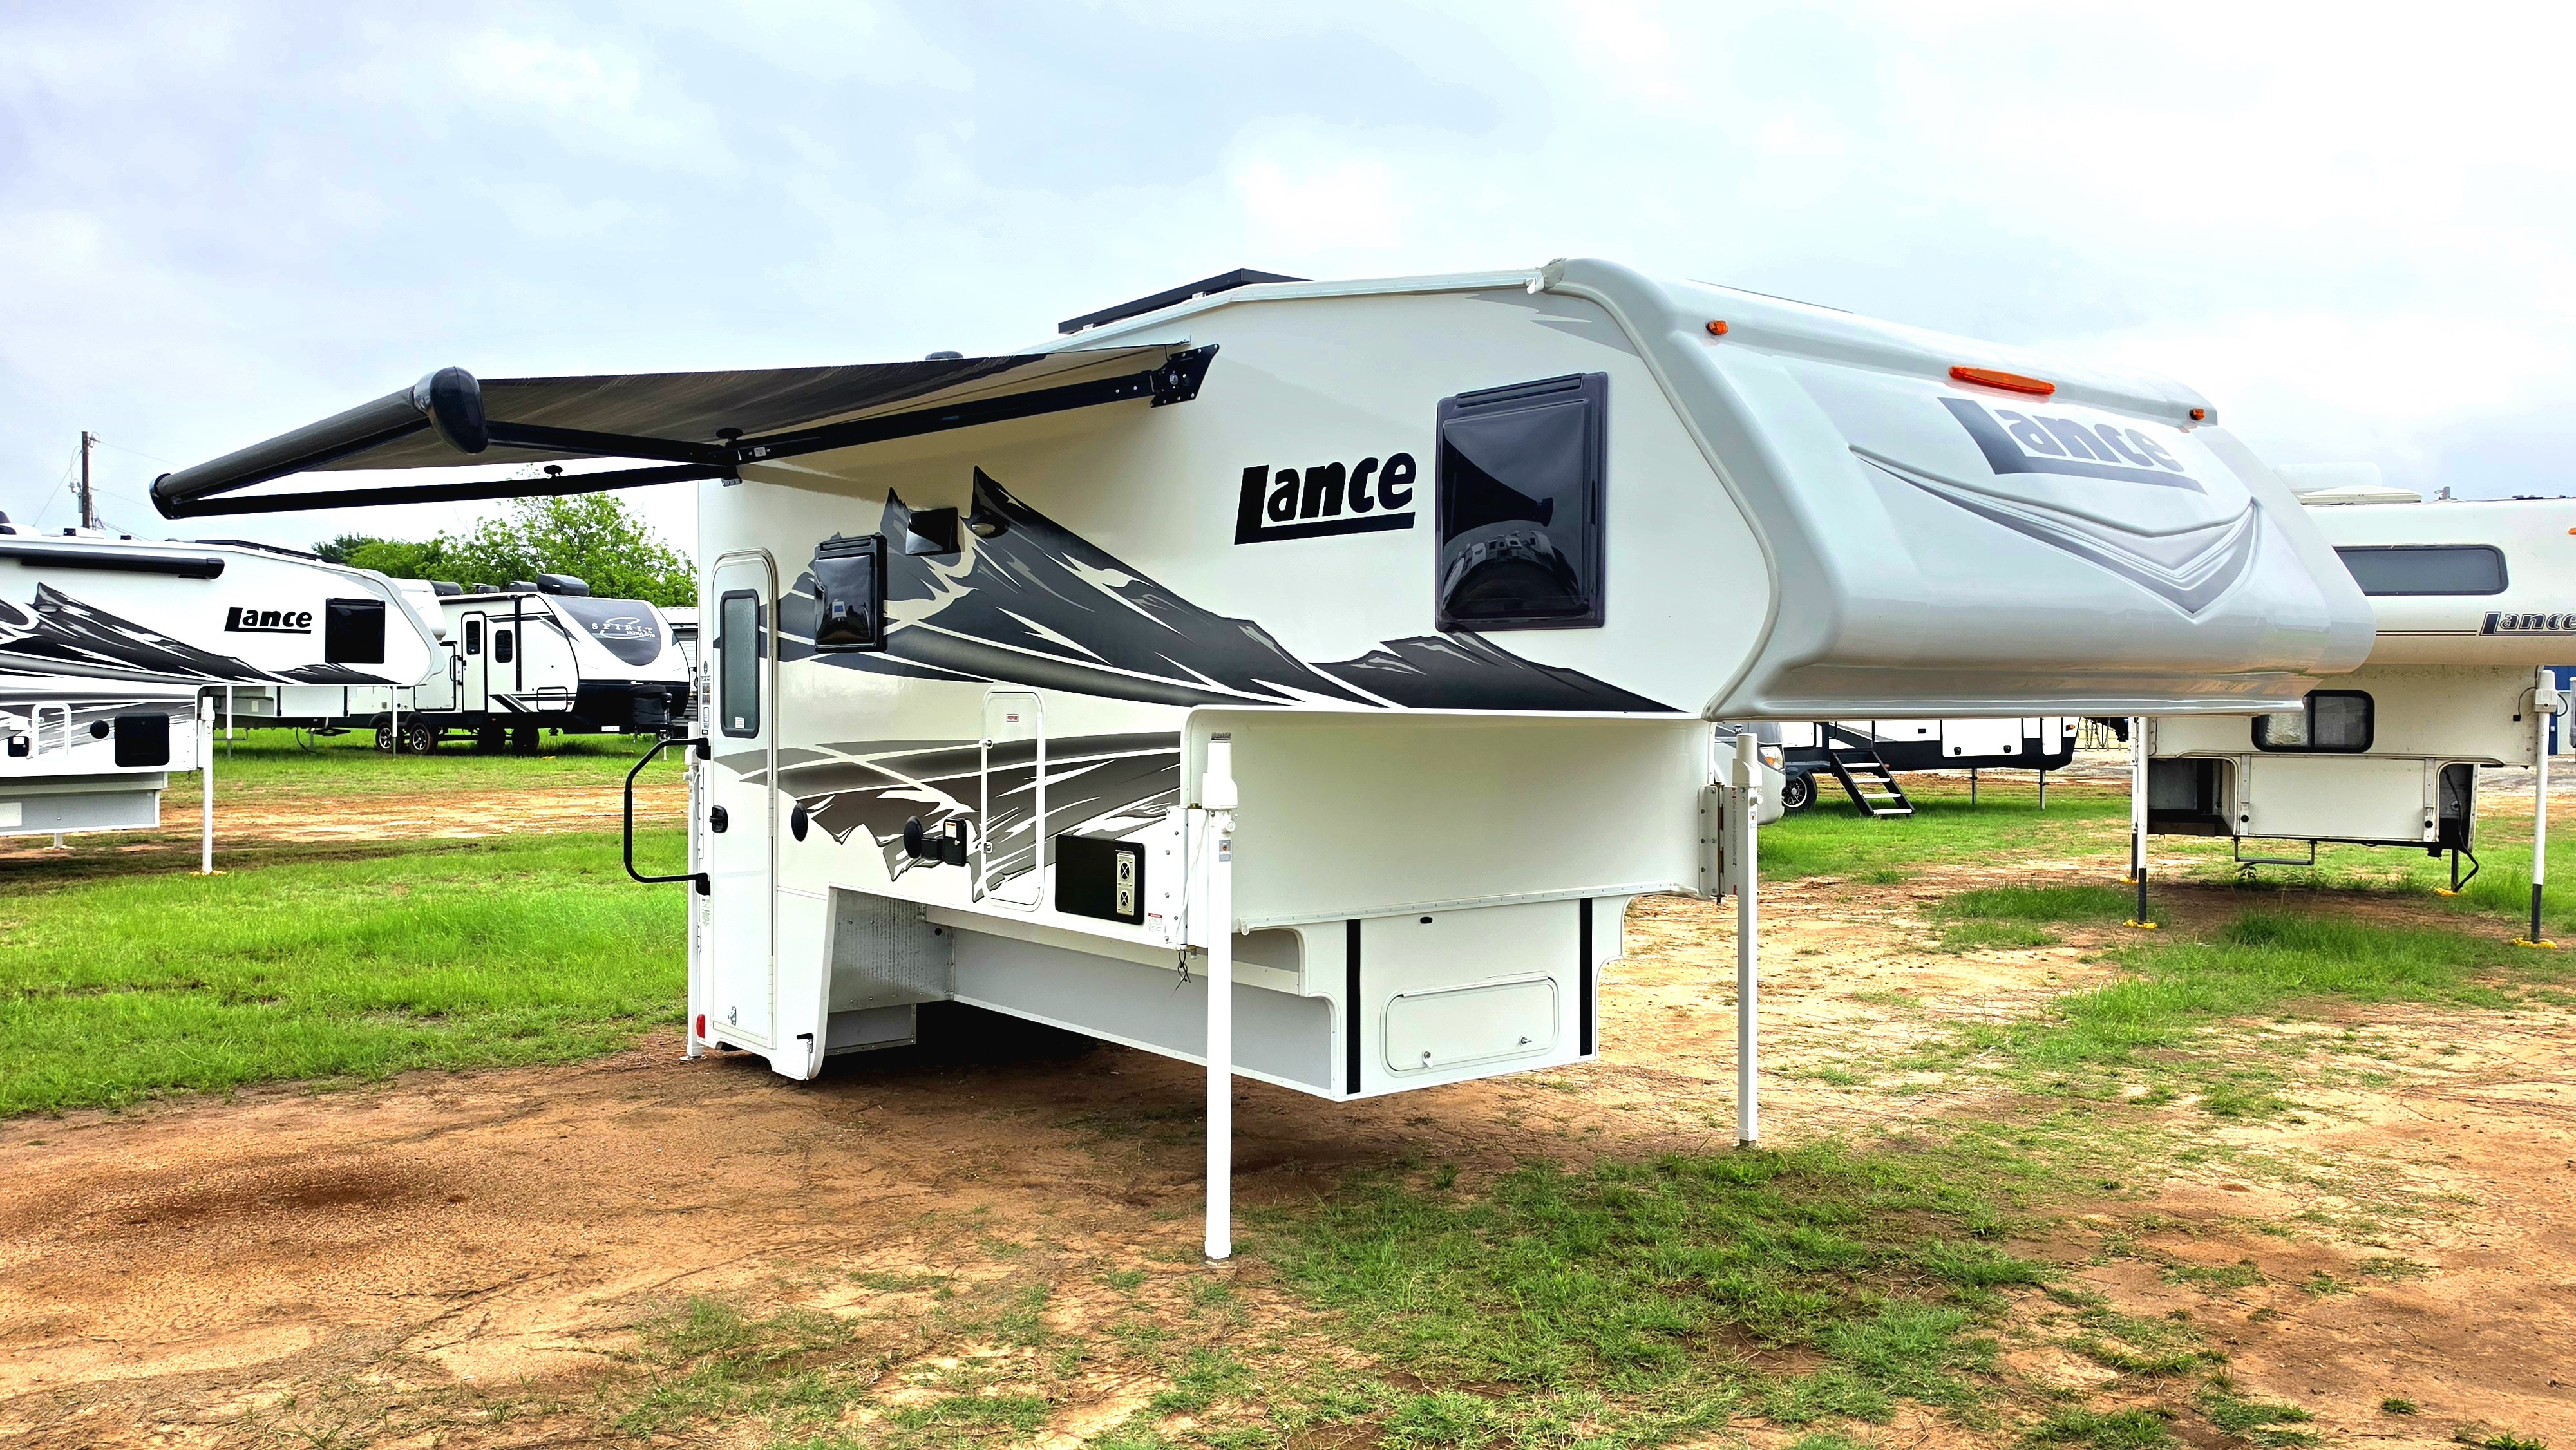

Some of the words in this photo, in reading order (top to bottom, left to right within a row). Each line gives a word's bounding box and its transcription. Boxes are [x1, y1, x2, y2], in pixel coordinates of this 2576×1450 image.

[1937, 397, 2208, 495] Lance
[1234, 452, 1417, 545] Lance
[224, 607, 312, 634] Lance
[591, 623, 653, 634] SPIRIT
[2479, 611, 2576, 636] Lance
